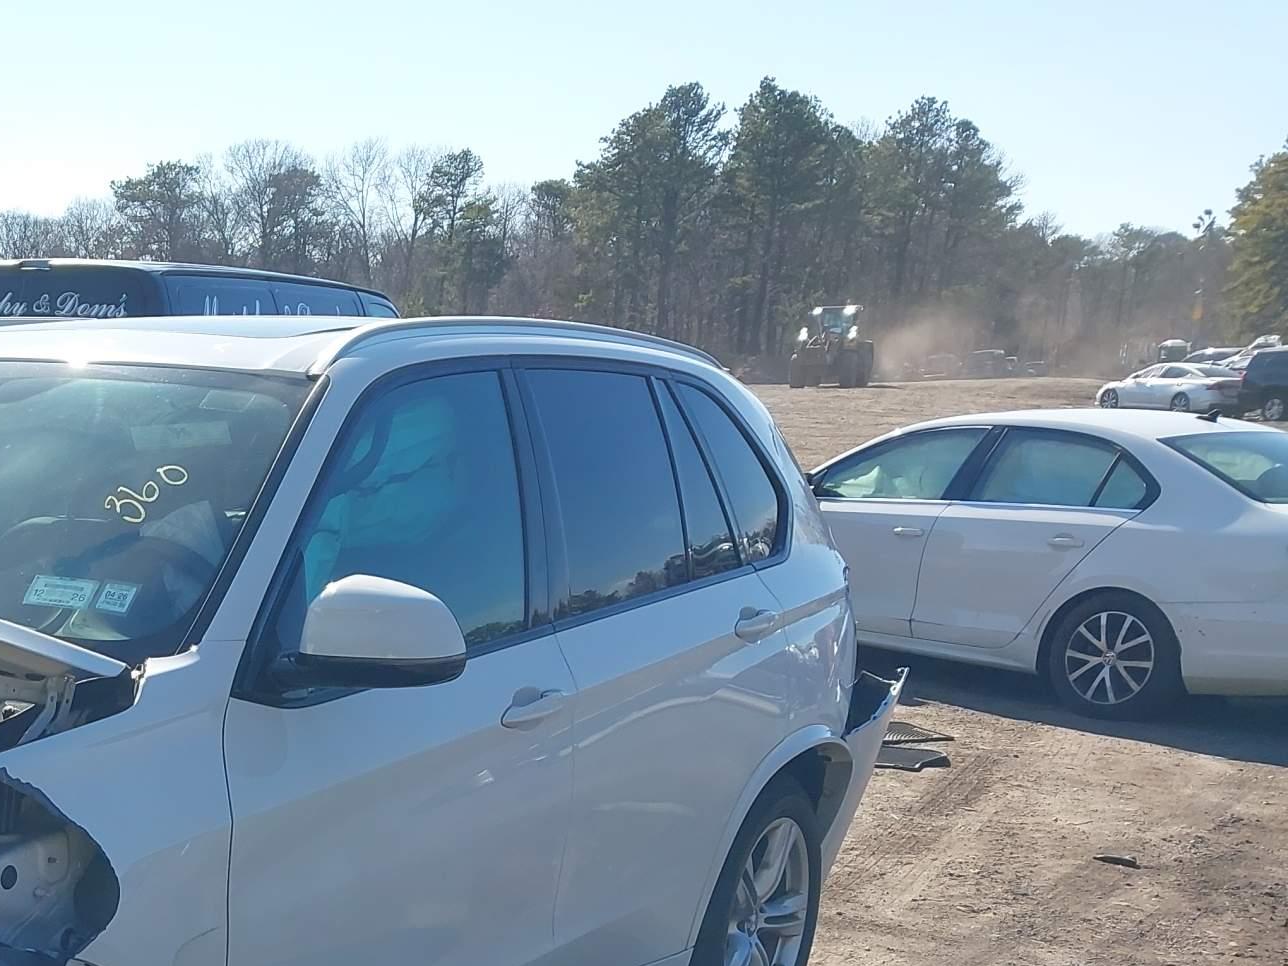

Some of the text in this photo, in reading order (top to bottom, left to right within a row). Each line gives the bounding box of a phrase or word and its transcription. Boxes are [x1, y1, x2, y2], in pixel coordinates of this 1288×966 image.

[32, 294, 50, 313] &
[104, 465, 188, 523] 360
[71, 592, 87, 602] 26
